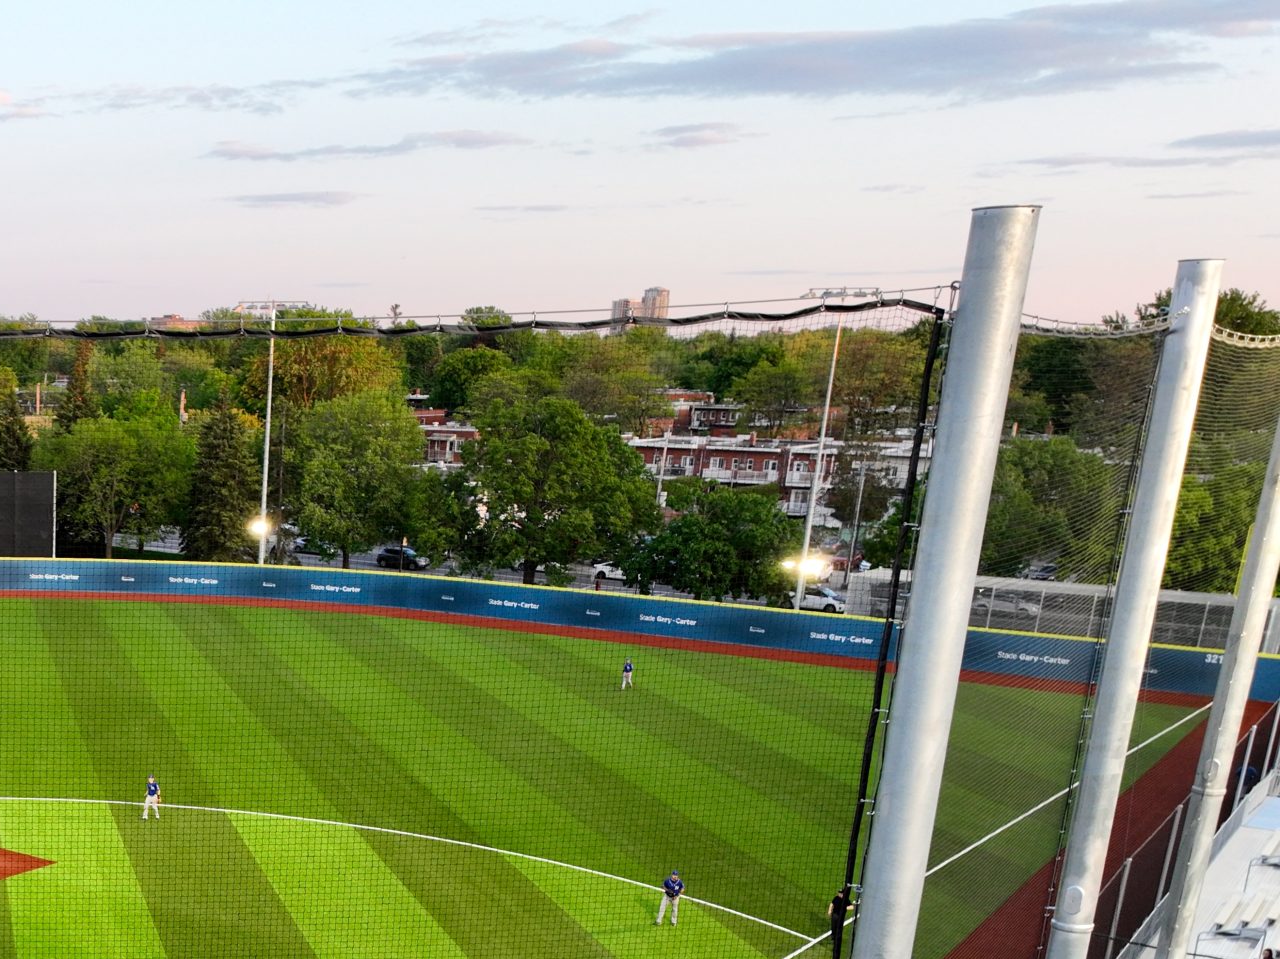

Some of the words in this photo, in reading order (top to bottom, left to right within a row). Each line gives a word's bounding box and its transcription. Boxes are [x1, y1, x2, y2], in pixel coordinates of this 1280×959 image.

[656, 615, 697, 626] Gary-Carter
[810, 632, 828, 640] Stade
[829, 633, 874, 645] Gary-Carter
[1019, 652, 1071, 665] Gary-Carter
[1204, 653, 1224, 664] 321
